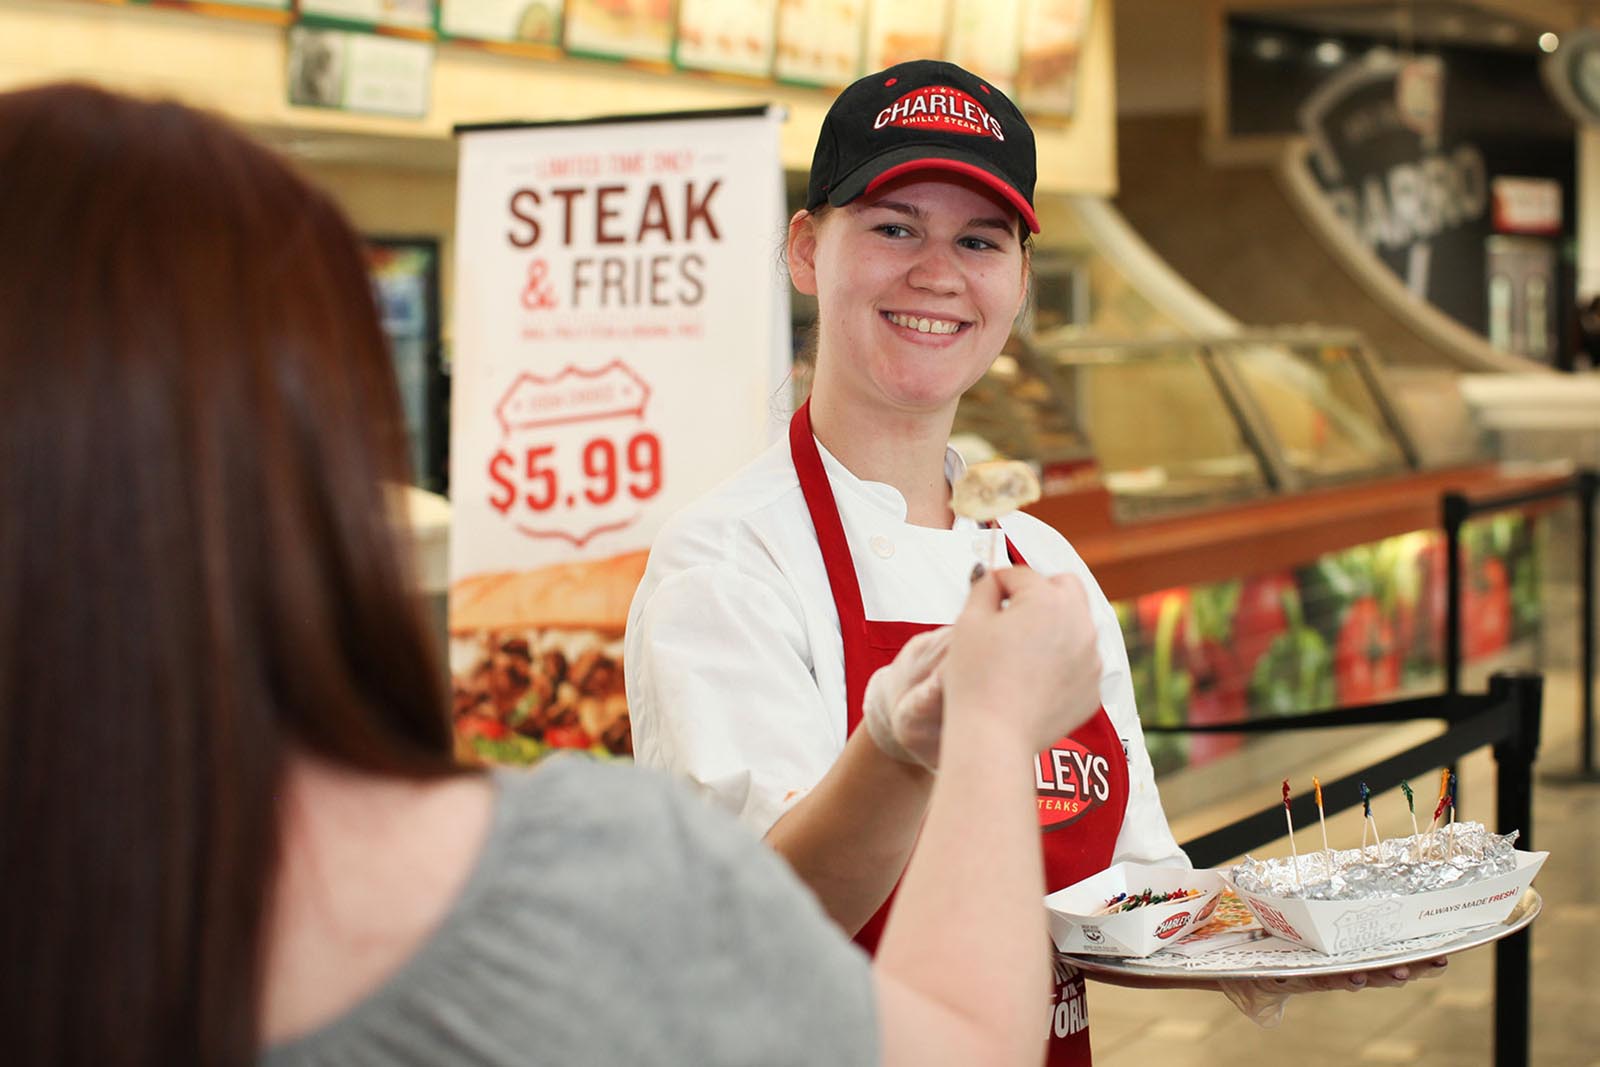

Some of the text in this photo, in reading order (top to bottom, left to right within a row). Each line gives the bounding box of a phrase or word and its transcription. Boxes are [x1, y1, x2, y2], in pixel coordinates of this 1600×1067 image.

[873, 94, 1005, 142] CHARLEYS
[902, 115, 982, 133] PHILLY STEAKS
[537, 149, 694, 178] LIMITED TIME ONLY
[508, 180, 723, 248] STEAK
[521, 253, 705, 310] & FRIES
[488, 431, 662, 516] $5.99
[1034, 749, 1109, 801] LEYS
[1037, 799, 1079, 812] TEAKS
[1461, 897, 1488, 910] MADE
[1047, 991, 1089, 1039] ORL
